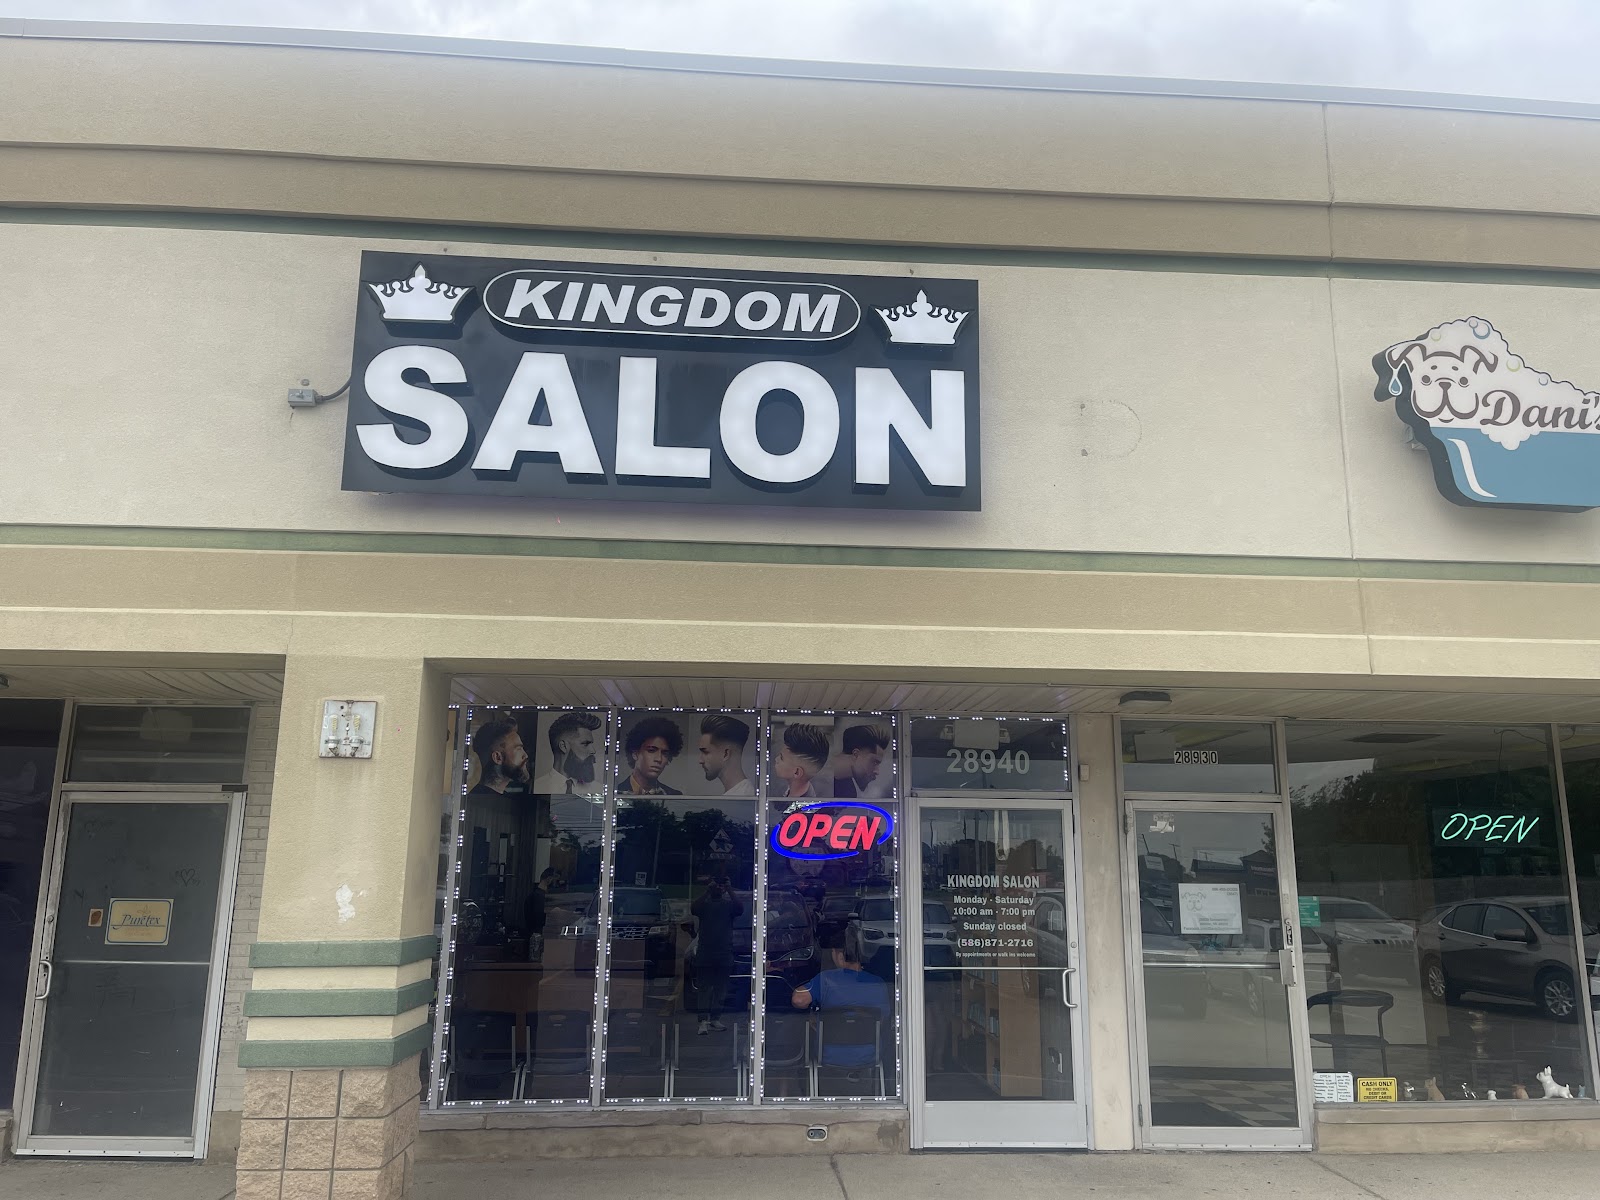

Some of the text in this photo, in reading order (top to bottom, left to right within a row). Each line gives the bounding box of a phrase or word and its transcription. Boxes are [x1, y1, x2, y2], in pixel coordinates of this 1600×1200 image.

[504, 278, 841, 333] KINGDOM
[356, 344, 967, 488] SALON
[946, 748, 1030, 775] 28940
[1174, 751, 1218, 764] 28930
[779, 812, 882, 850] OPEN
[1441, 812, 1540, 843] OPEN
[947, 874, 1040, 888] KINGDOM SALON
[953, 895, 987, 905] Monday
[995, 895, 1034, 906] Saturday
[953, 907, 978, 916] 10:00
[1000, 907, 1020, 916] 7:00
[1022, 908, 1036, 917] pm
[963, 922, 1027, 932] Sunday closed
[957, 938, 1034, 948] (586)871-2716
